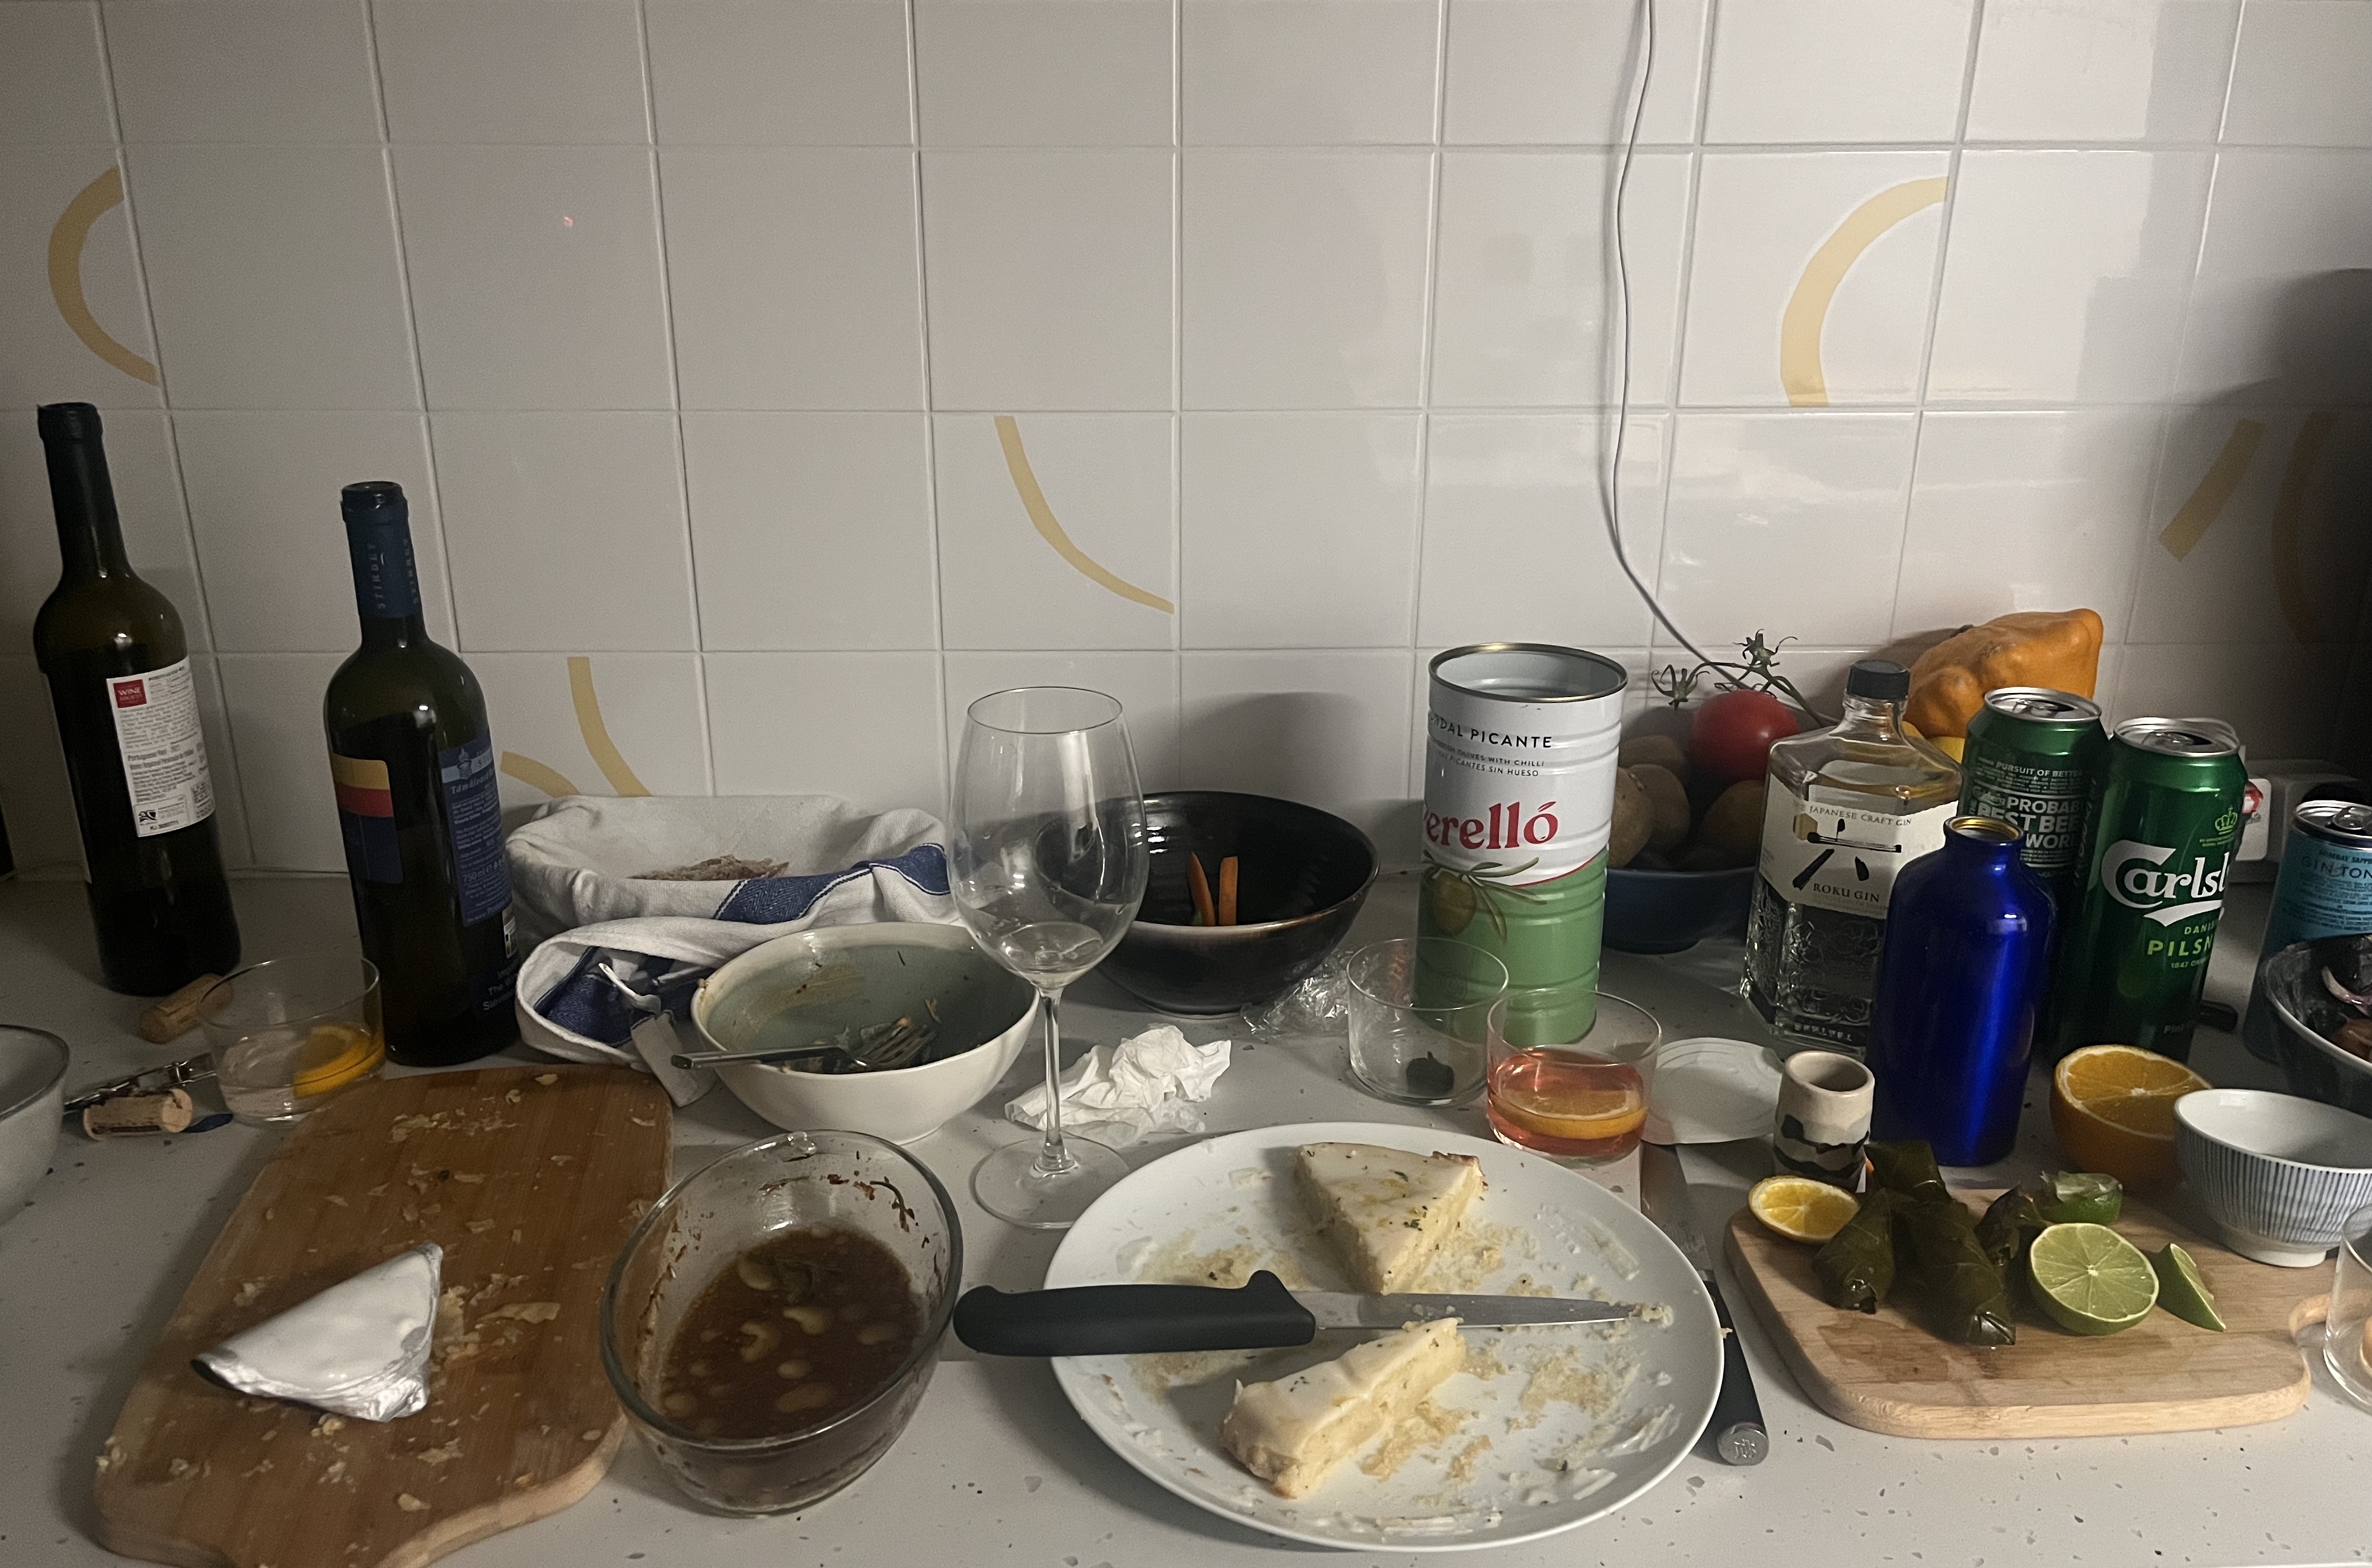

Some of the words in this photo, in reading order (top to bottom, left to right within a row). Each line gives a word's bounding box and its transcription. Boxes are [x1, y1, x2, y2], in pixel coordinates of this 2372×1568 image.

[117, 686, 141, 695] WINE
[1470, 729, 1552, 749] PICANTE
[1449, 755, 1485, 772] PICANTES
[1488, 766, 1504, 774] SIN
[1506, 768, 1539, 777] HUESO
[1458, 749, 1485, 762] OLIVES
[1487, 756, 1511, 765] WITH
[1995, 761, 2036, 775] PURSUIT
[1424, 801, 1557, 850] erelló
[1809, 806, 1857, 820] JAPANESE
[1860, 814, 1895, 826] CRAFT
[2301, 855, 2334, 873] GIN
[1813, 883, 1850, 898] ROKU
[1854, 890, 1880, 903] GIN
[2170, 961, 2189, 969] 1847
